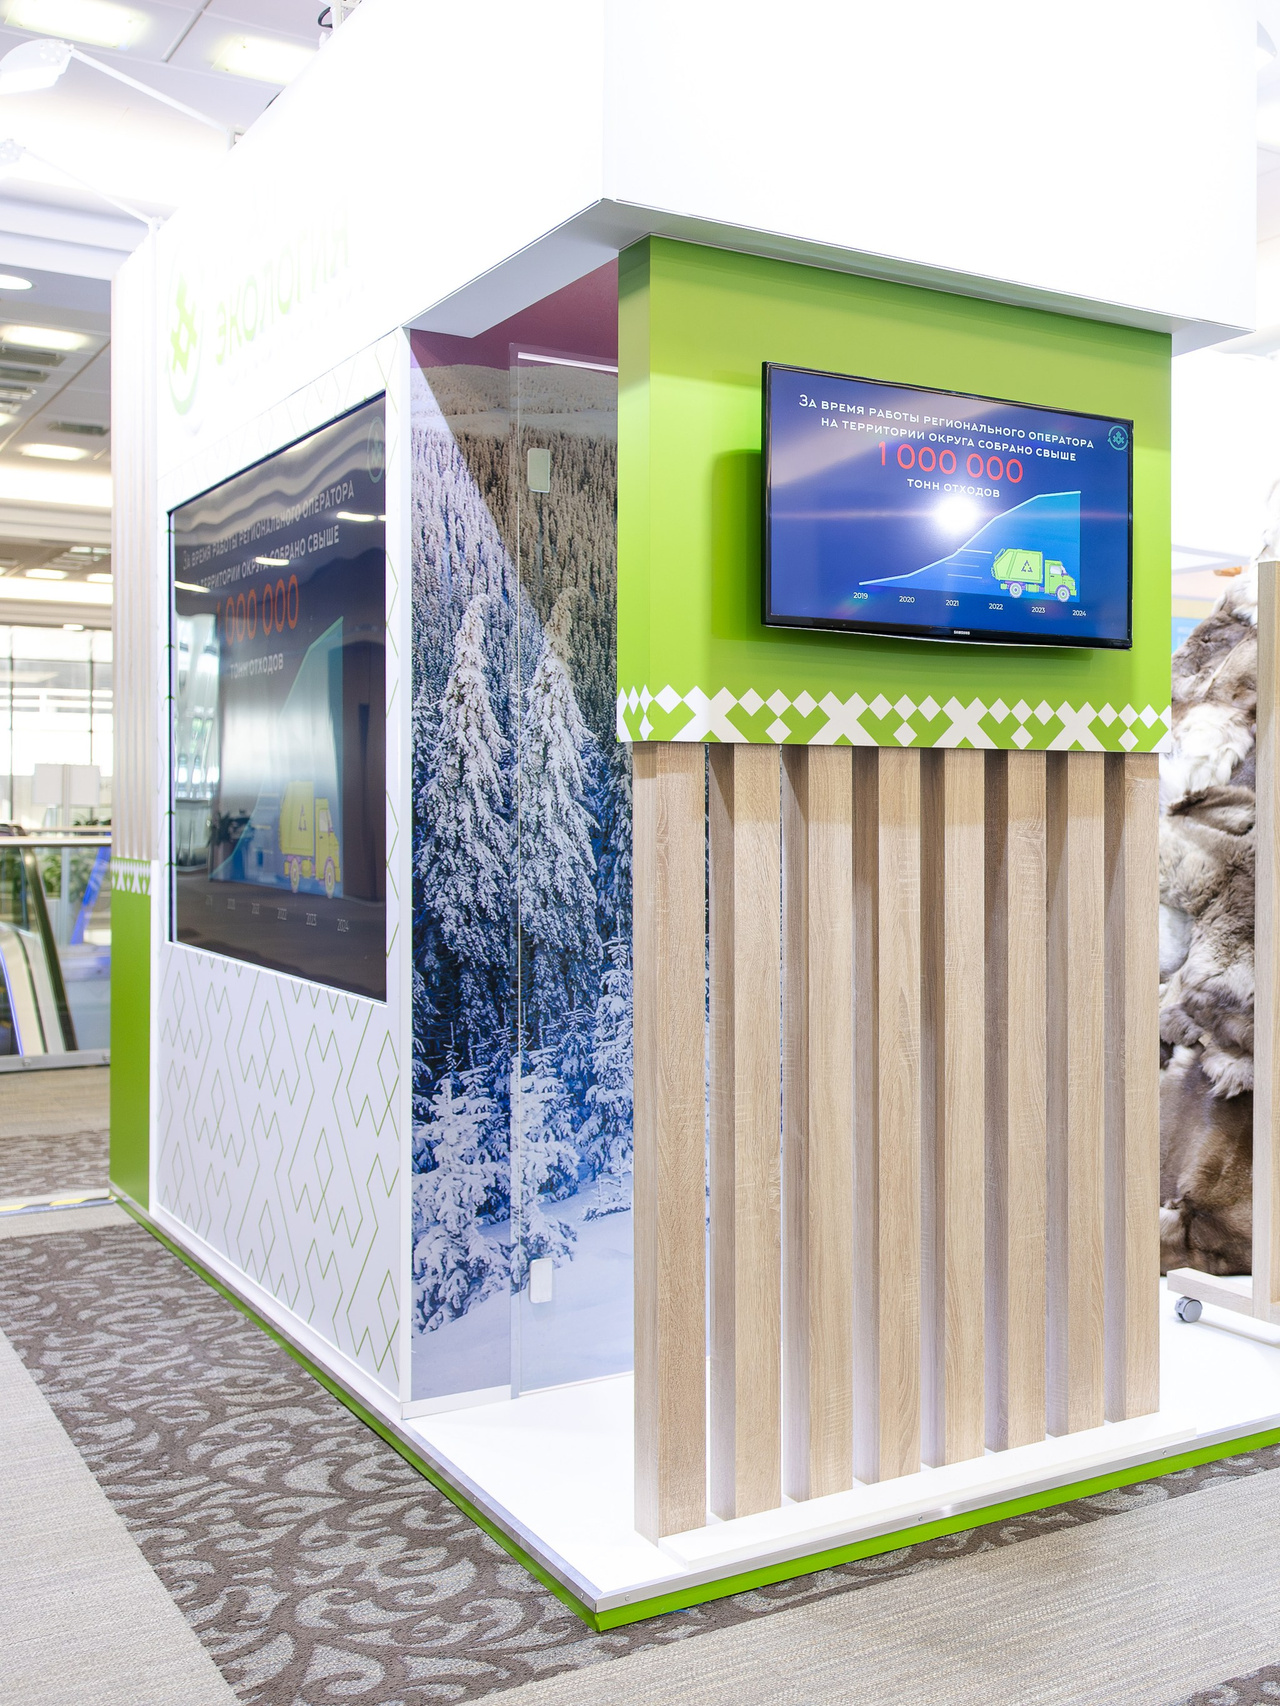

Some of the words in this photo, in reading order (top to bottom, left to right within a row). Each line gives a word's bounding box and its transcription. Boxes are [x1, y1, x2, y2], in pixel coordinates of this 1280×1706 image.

[821, 400, 864, 415] ВРЕМЯ
[869, 407, 919, 423] РАБОТЫ
[924, 416, 1025, 438] РЕГИОНАЛЬНОГО
[1028, 431, 1094, 449] ОПЕРАТОРА
[821, 417, 838, 428] НА
[842, 420, 925, 440] ТЕРРИТОРИИ
[928, 432, 974, 447] ОКРУГА
[978, 440, 1033, 455] СОБРАНО
[1035, 448, 1076, 461] СВЫШЕ
[878, 440, 886, 466] 1
[897, 444, 957, 475] 000
[966, 453, 1023, 484] 000
[302, 480, 354, 518] ОПЕРАТОРА
[907, 478, 940, 491] ТОНН
[943, 483, 1000, 498] ОТХОДОВ
[308, 524, 339, 553] СВЫШЕ
[225, 588, 258, 646] 000
[262, 574, 299, 637] 000
[853, 592, 868, 600] 2019
